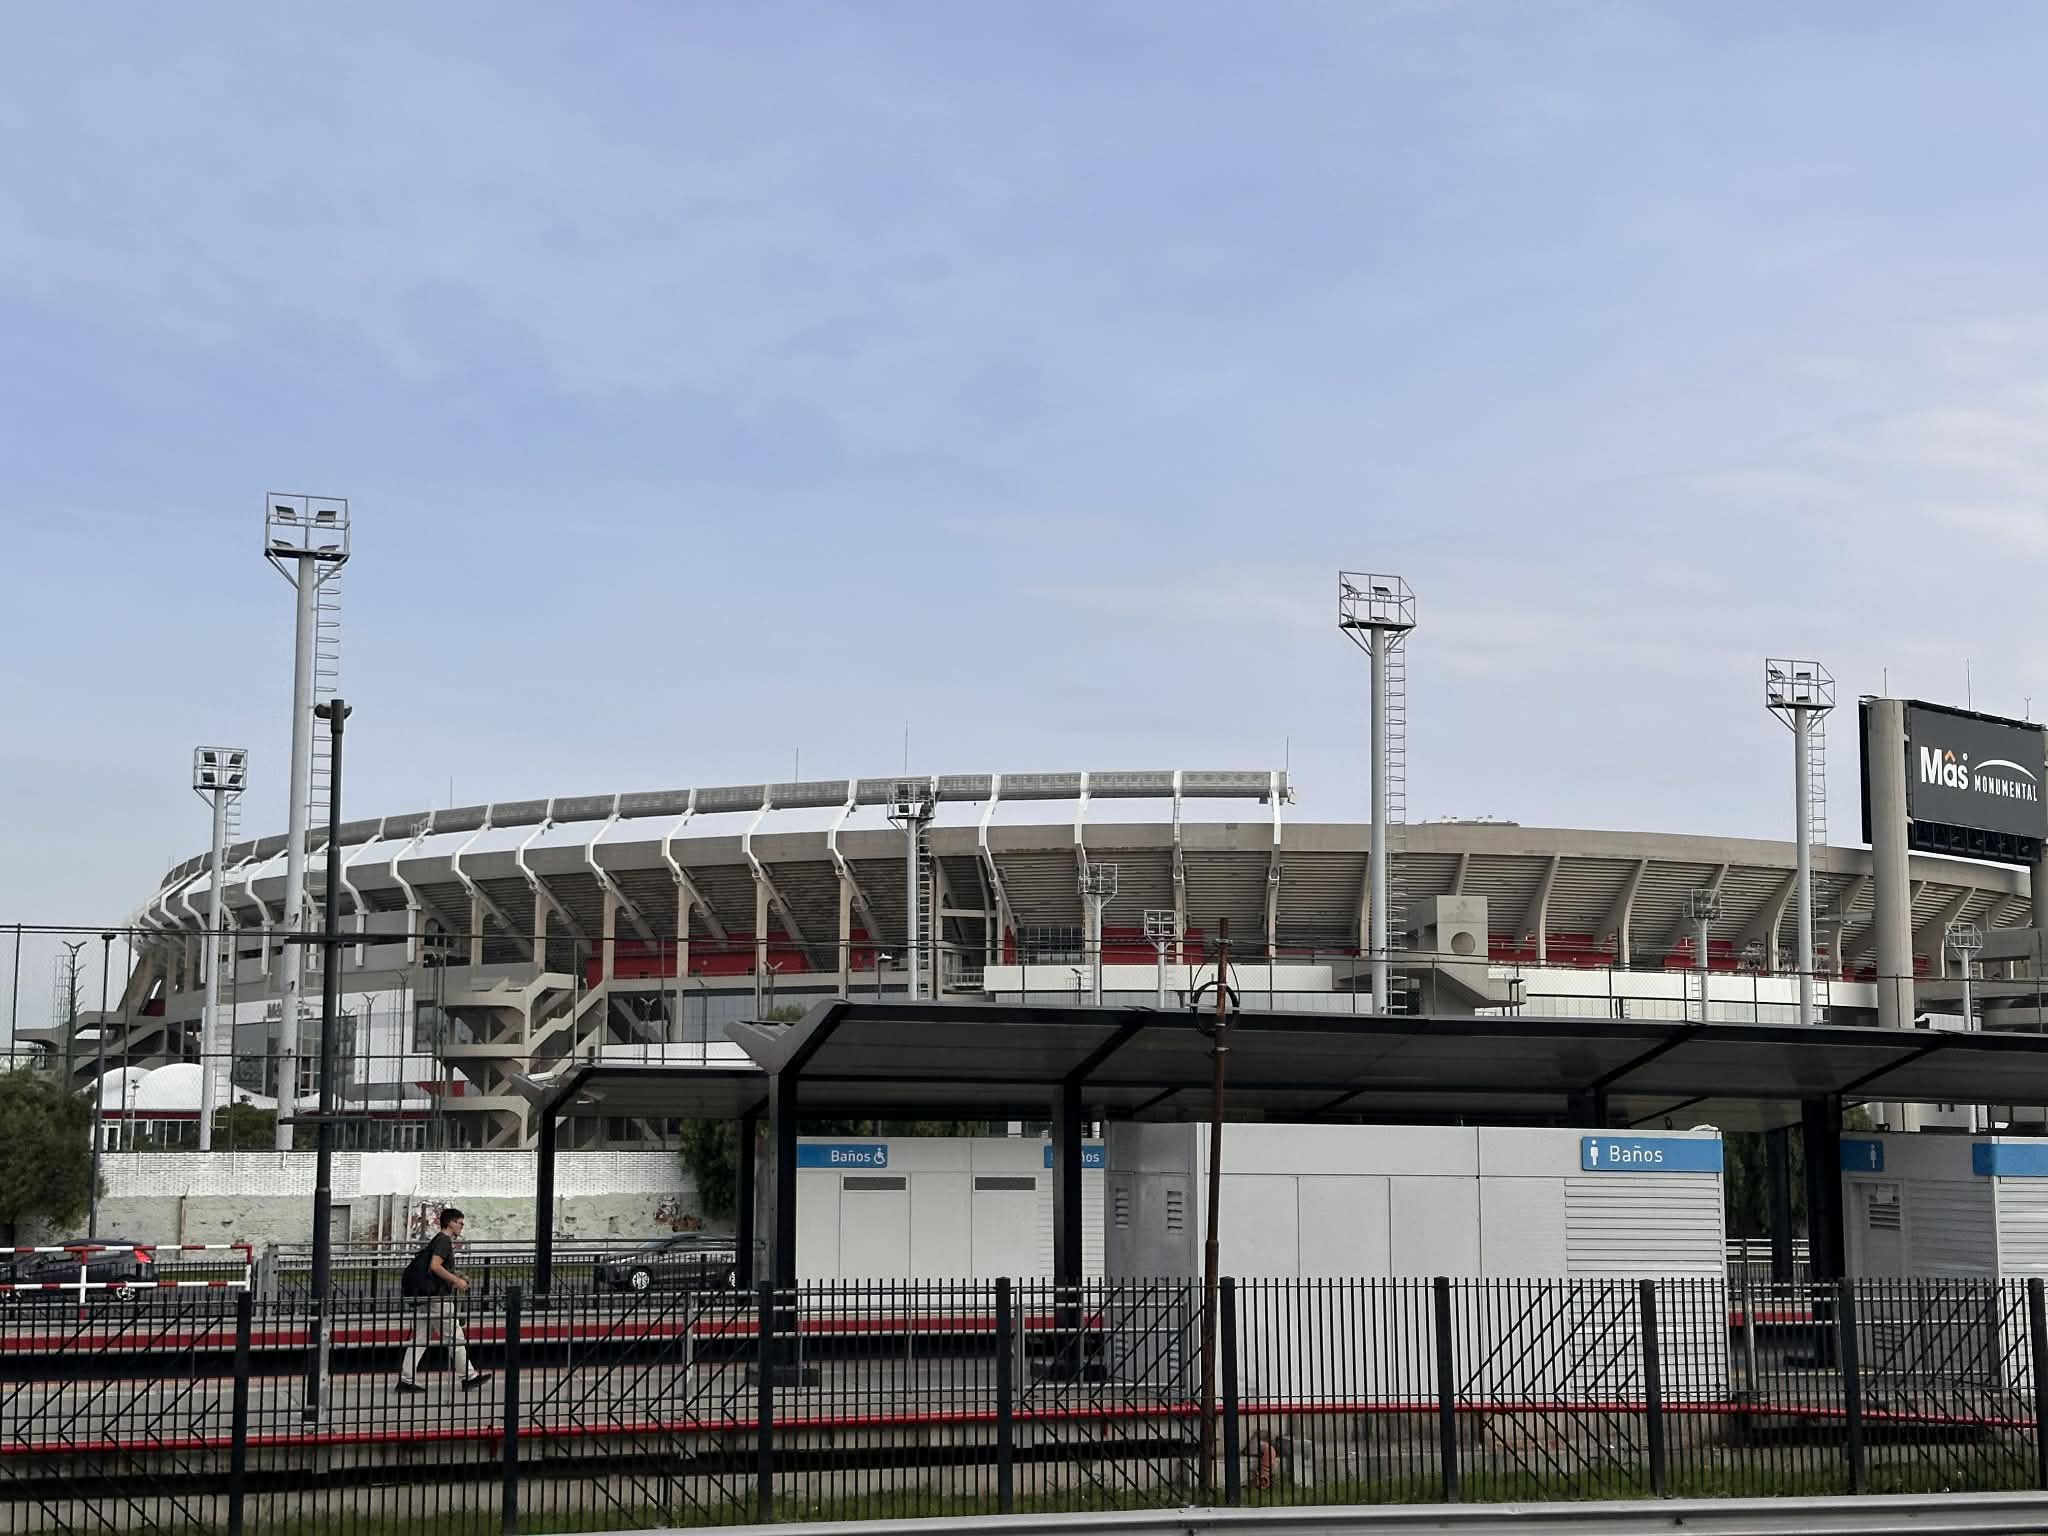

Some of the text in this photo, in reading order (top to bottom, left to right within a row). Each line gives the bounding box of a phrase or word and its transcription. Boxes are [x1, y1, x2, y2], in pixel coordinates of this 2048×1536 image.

[1974, 774, 2038, 801] MONUMENTAL
[831, 1150, 871, 1162] Baños
[1609, 1145, 1664, 1163] Baños
